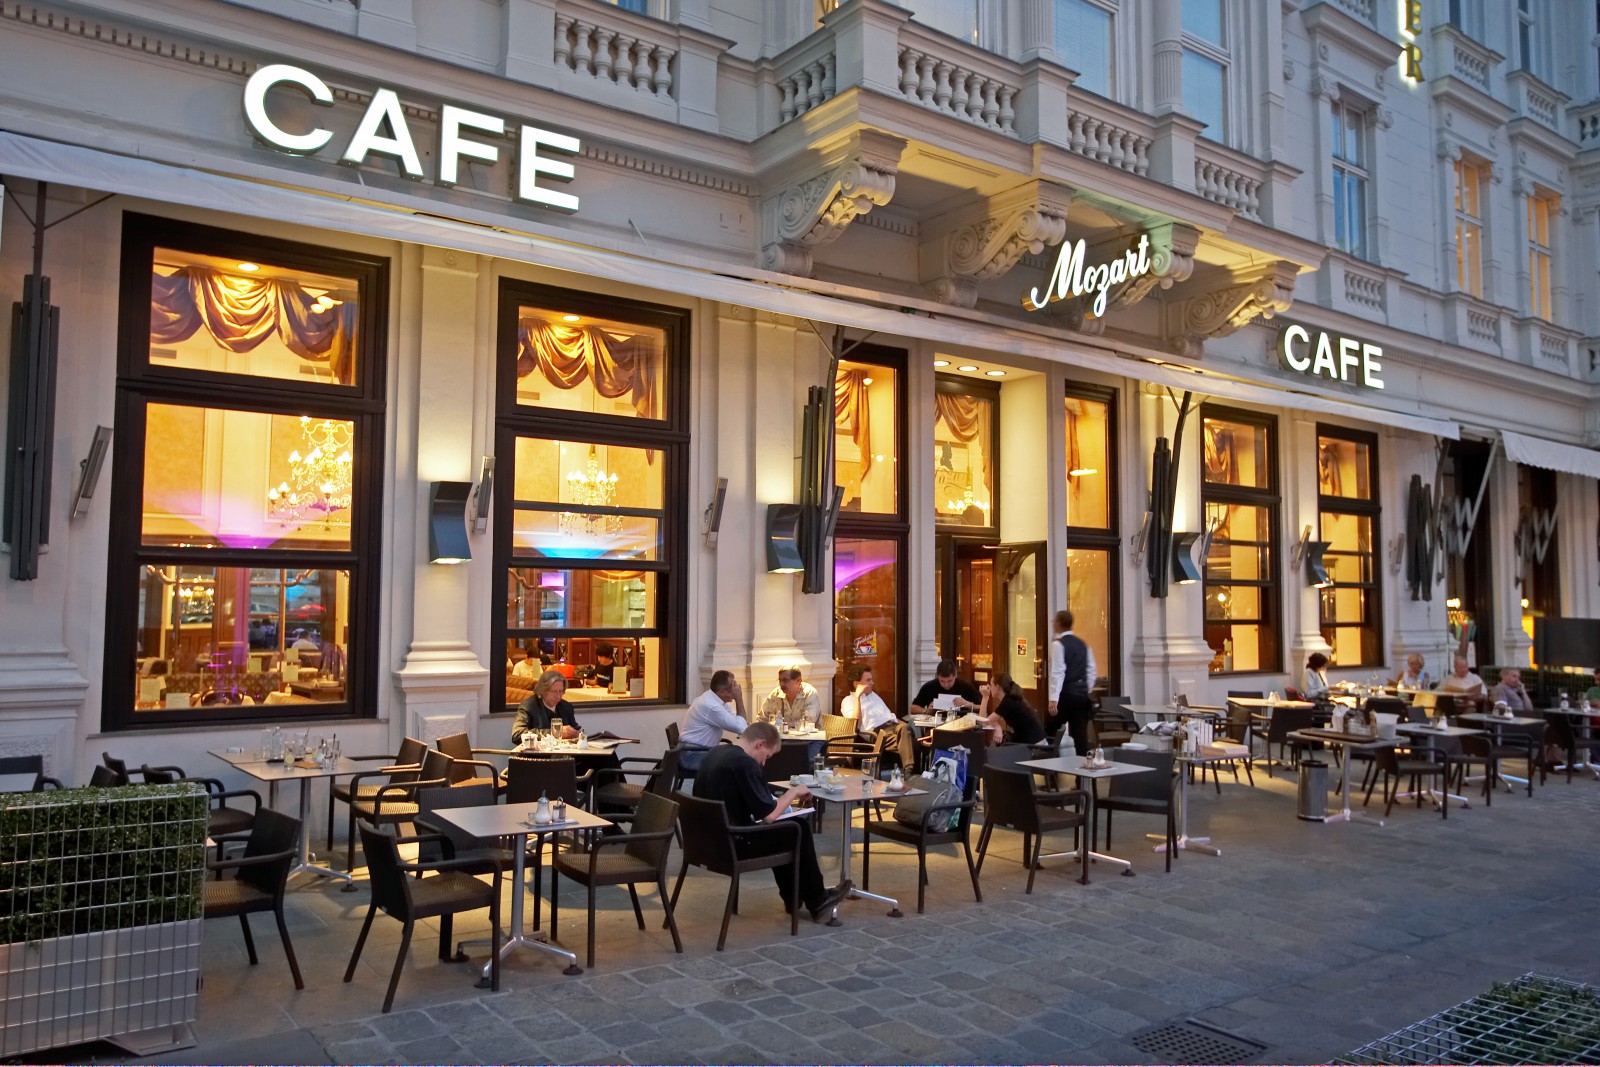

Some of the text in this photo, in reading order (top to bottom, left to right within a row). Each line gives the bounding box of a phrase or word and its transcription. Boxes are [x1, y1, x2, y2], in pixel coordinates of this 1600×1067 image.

[243, 64, 580, 212] CAFE
[1030, 234, 1150, 317] Mozart
[1283, 324, 1385, 389] CAFE
